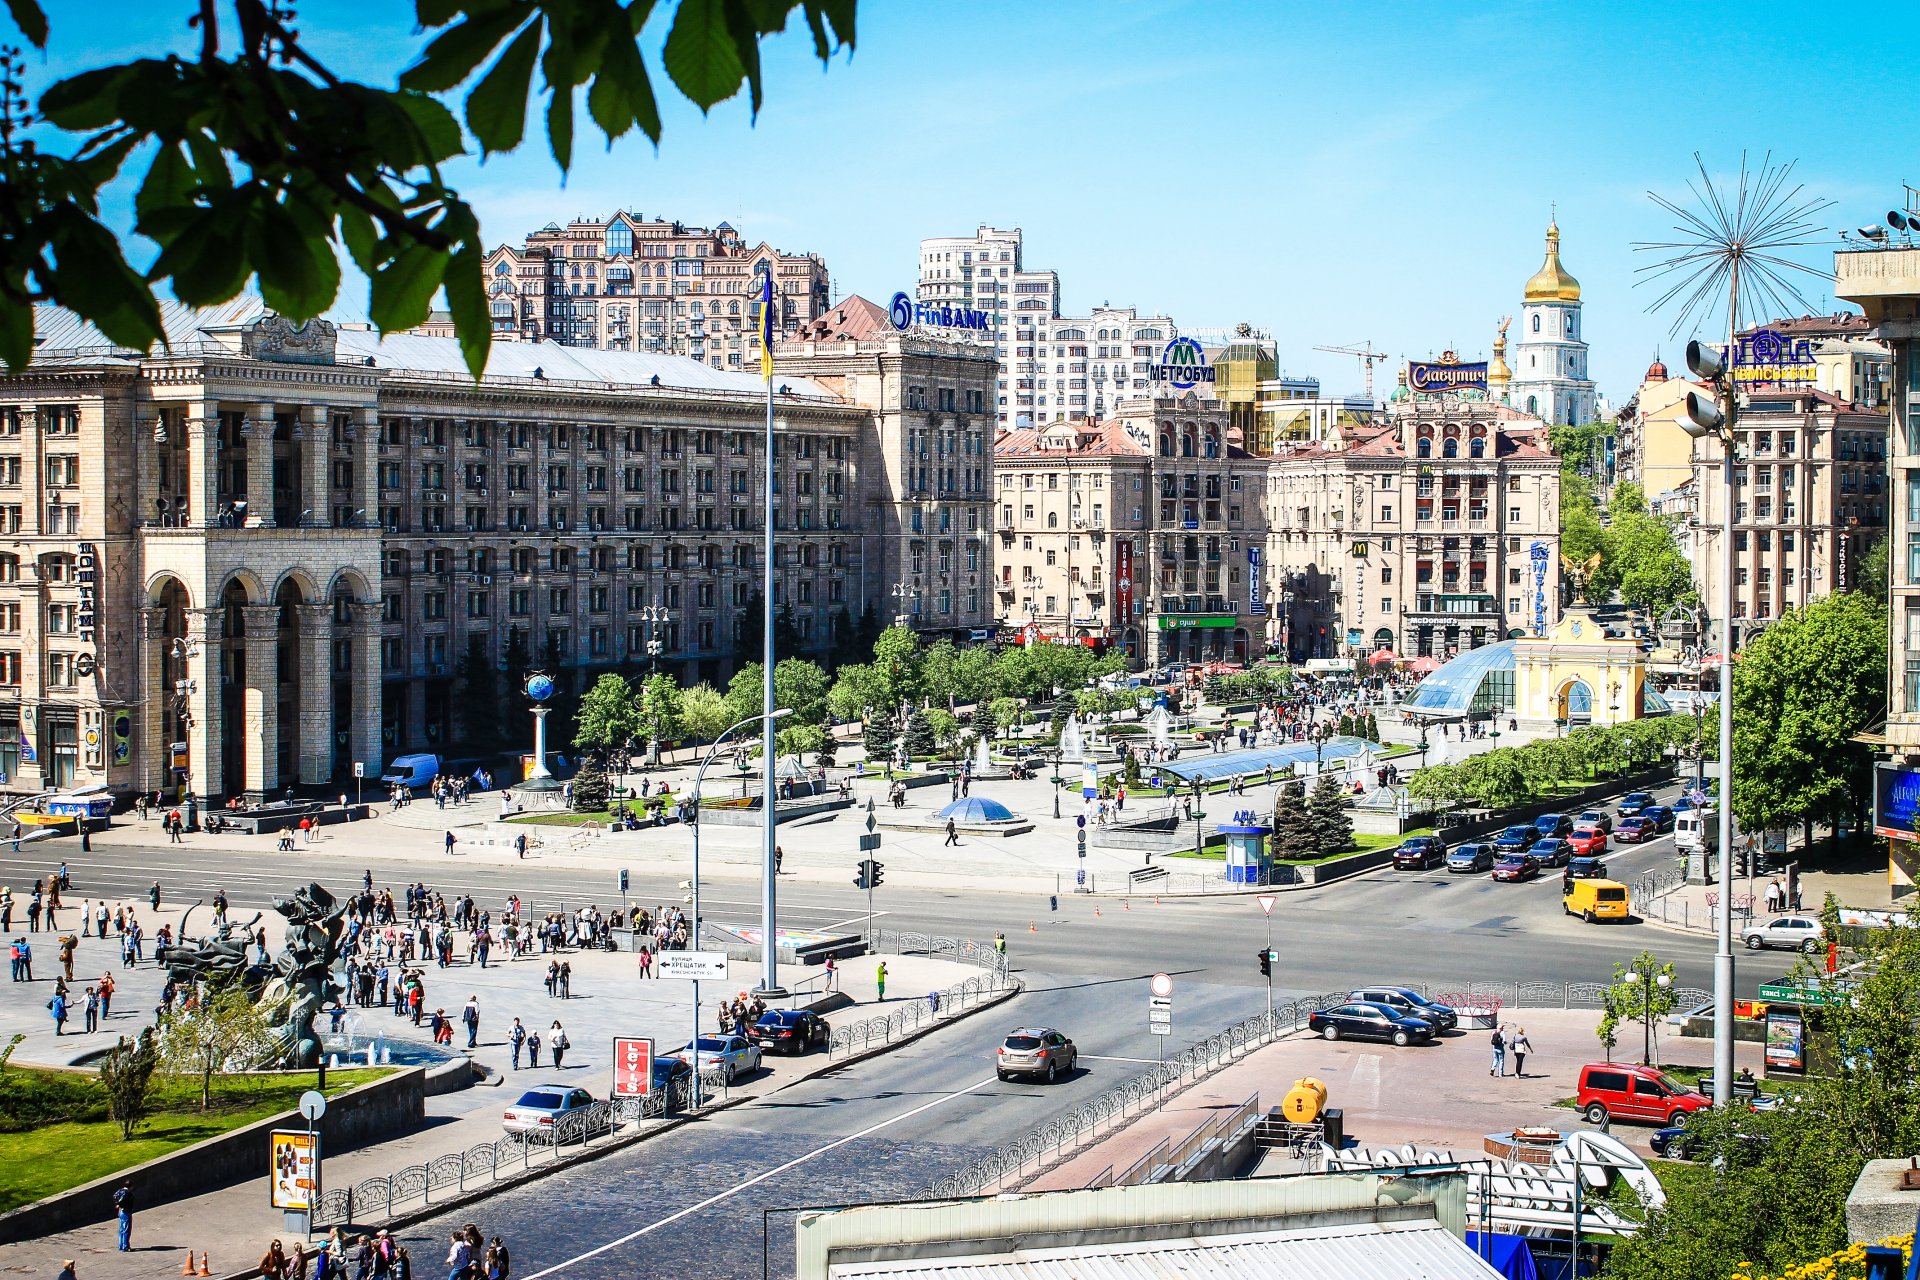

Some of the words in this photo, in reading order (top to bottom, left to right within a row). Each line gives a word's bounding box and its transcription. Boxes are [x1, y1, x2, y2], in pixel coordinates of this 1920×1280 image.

[914, 303, 989, 331] FinBANK
[1150, 364, 1216, 383] МЕТРОБУД
[1412, 365, 1486, 388] Славутич
[79, 542, 94, 642] ПОШТАМТ
[1410, 617, 1458, 625] McDonald's
